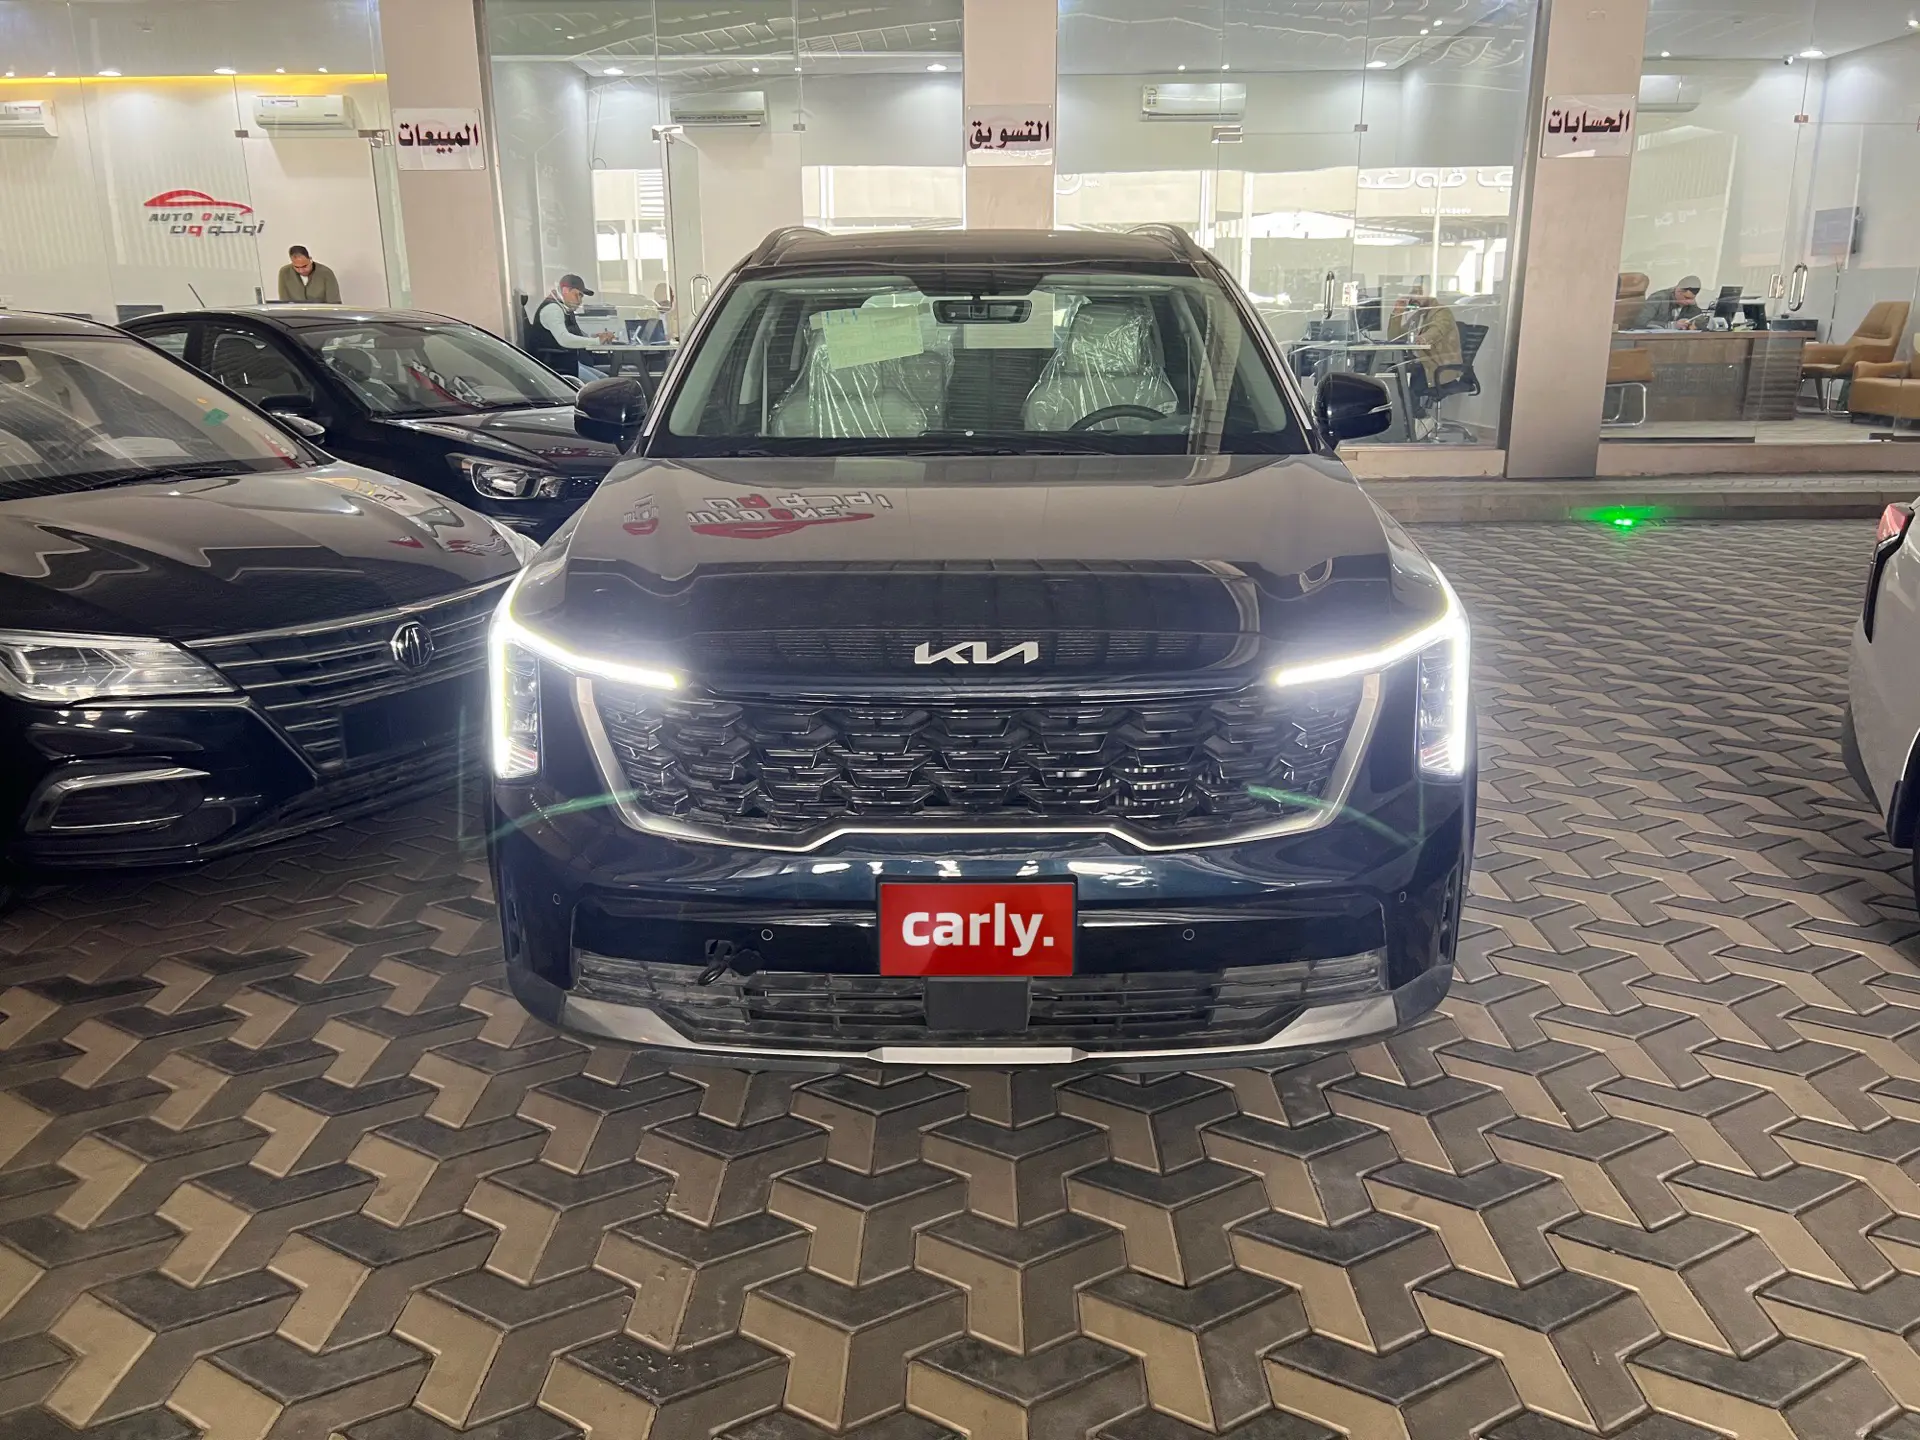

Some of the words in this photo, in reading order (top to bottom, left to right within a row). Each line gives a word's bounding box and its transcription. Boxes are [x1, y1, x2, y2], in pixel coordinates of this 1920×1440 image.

[398, 122, 479, 154] المبيعات
[969, 120, 1050, 150] التسويق
[1547, 108, 1631, 143] الحسابات
[148, 212, 193, 222] AUTO
[201, 212, 236, 222] ONE
[914, 641, 1039, 664] KIA
[902, 902, 1054, 957] carly.
